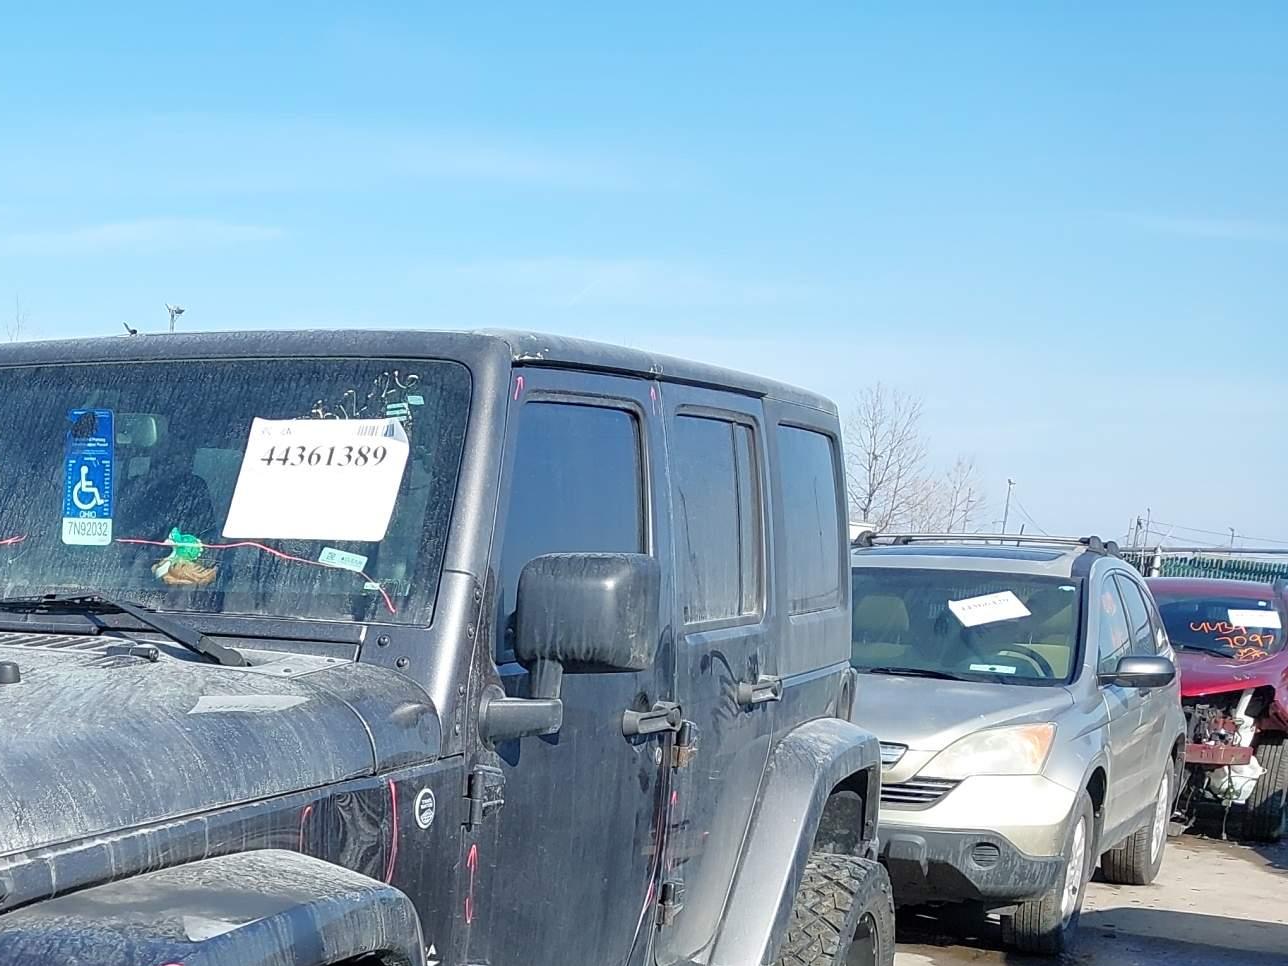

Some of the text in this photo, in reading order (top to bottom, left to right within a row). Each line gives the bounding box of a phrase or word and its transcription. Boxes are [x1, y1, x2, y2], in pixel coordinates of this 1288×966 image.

[260, 445, 387, 466] 44361389
[68, 521, 108, 537] 7N92032
[1213, 633, 1274, 649] 7097
